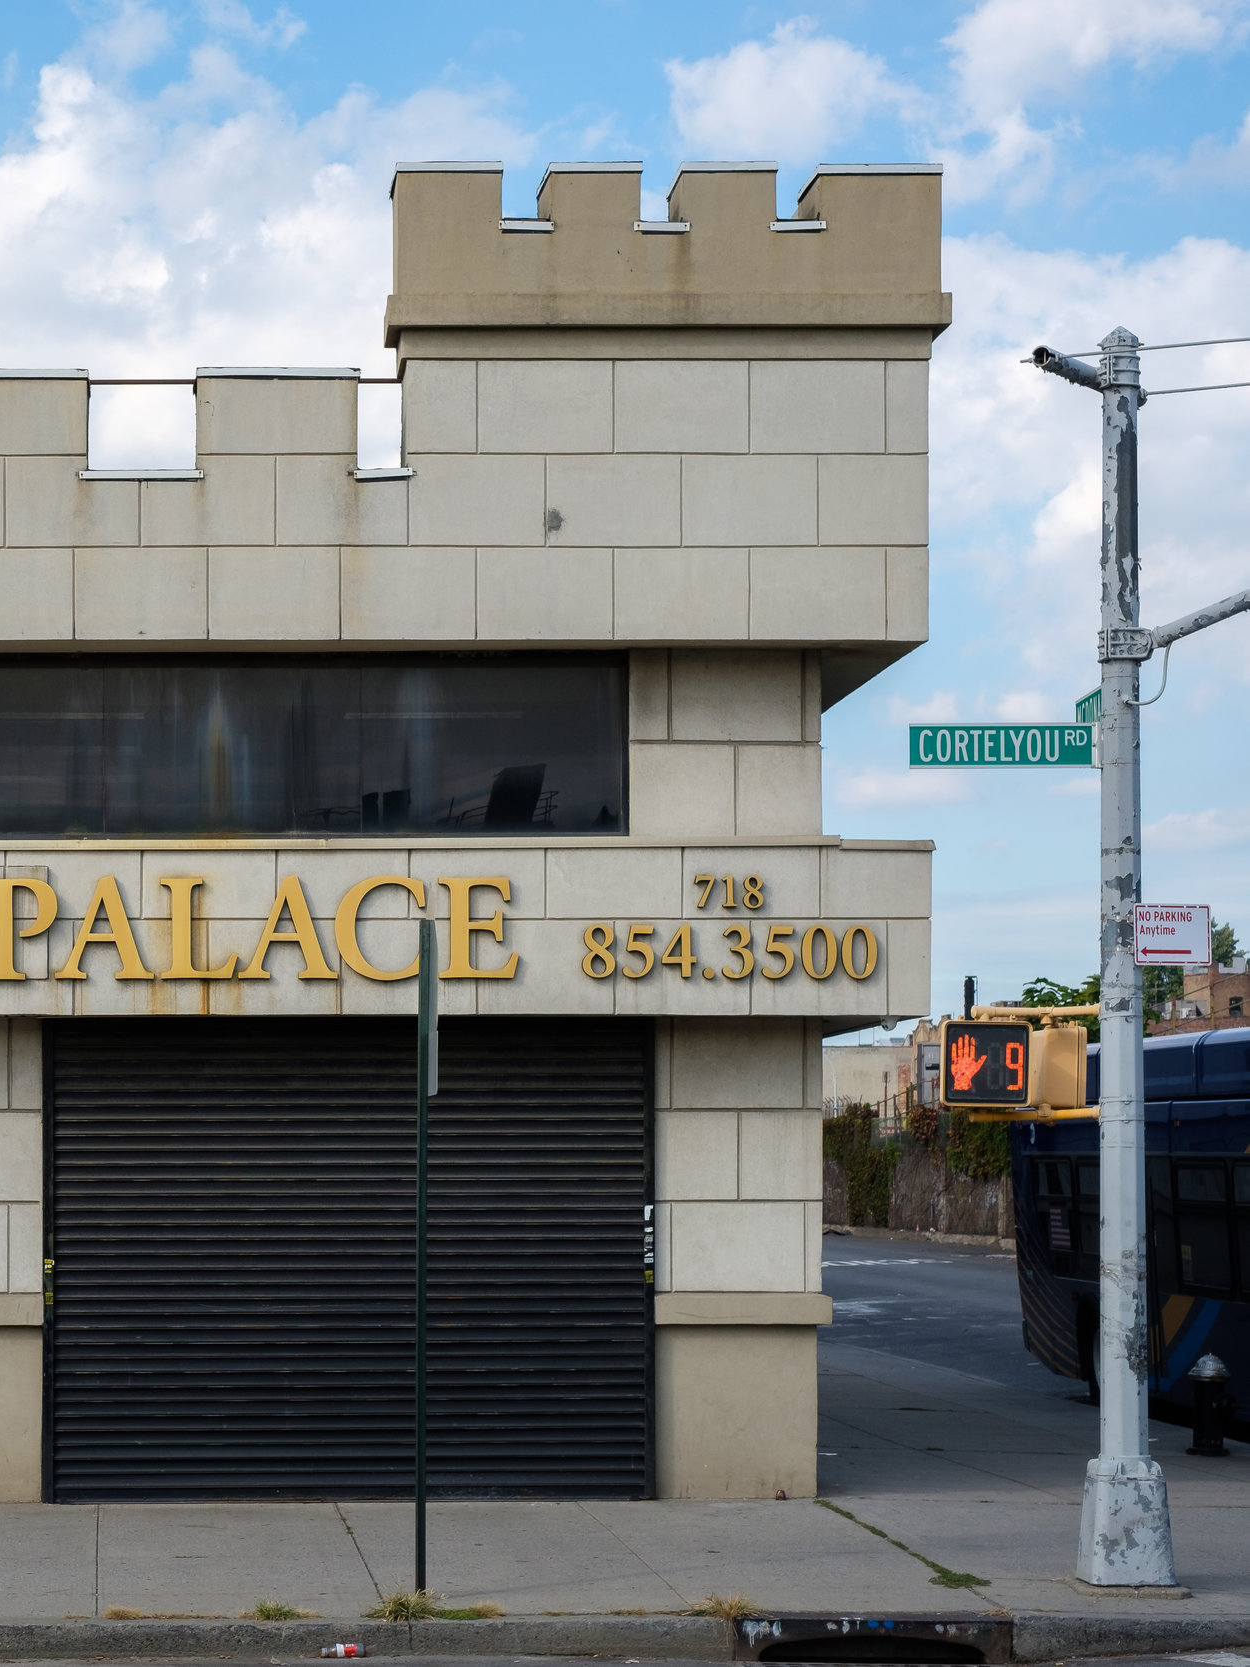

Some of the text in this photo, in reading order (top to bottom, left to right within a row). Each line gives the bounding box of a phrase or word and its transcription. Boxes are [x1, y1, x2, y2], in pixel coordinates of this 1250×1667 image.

[918, 728, 1088, 763] CORTELYOU RD
[694, 874, 765, 910] 718
[1138, 910, 1193, 923] NO PARKING
[1139, 924, 1176, 938] Anytime
[581, 924, 879, 980] 854.3500
[1005, 1041, 1024, 1091] 9
